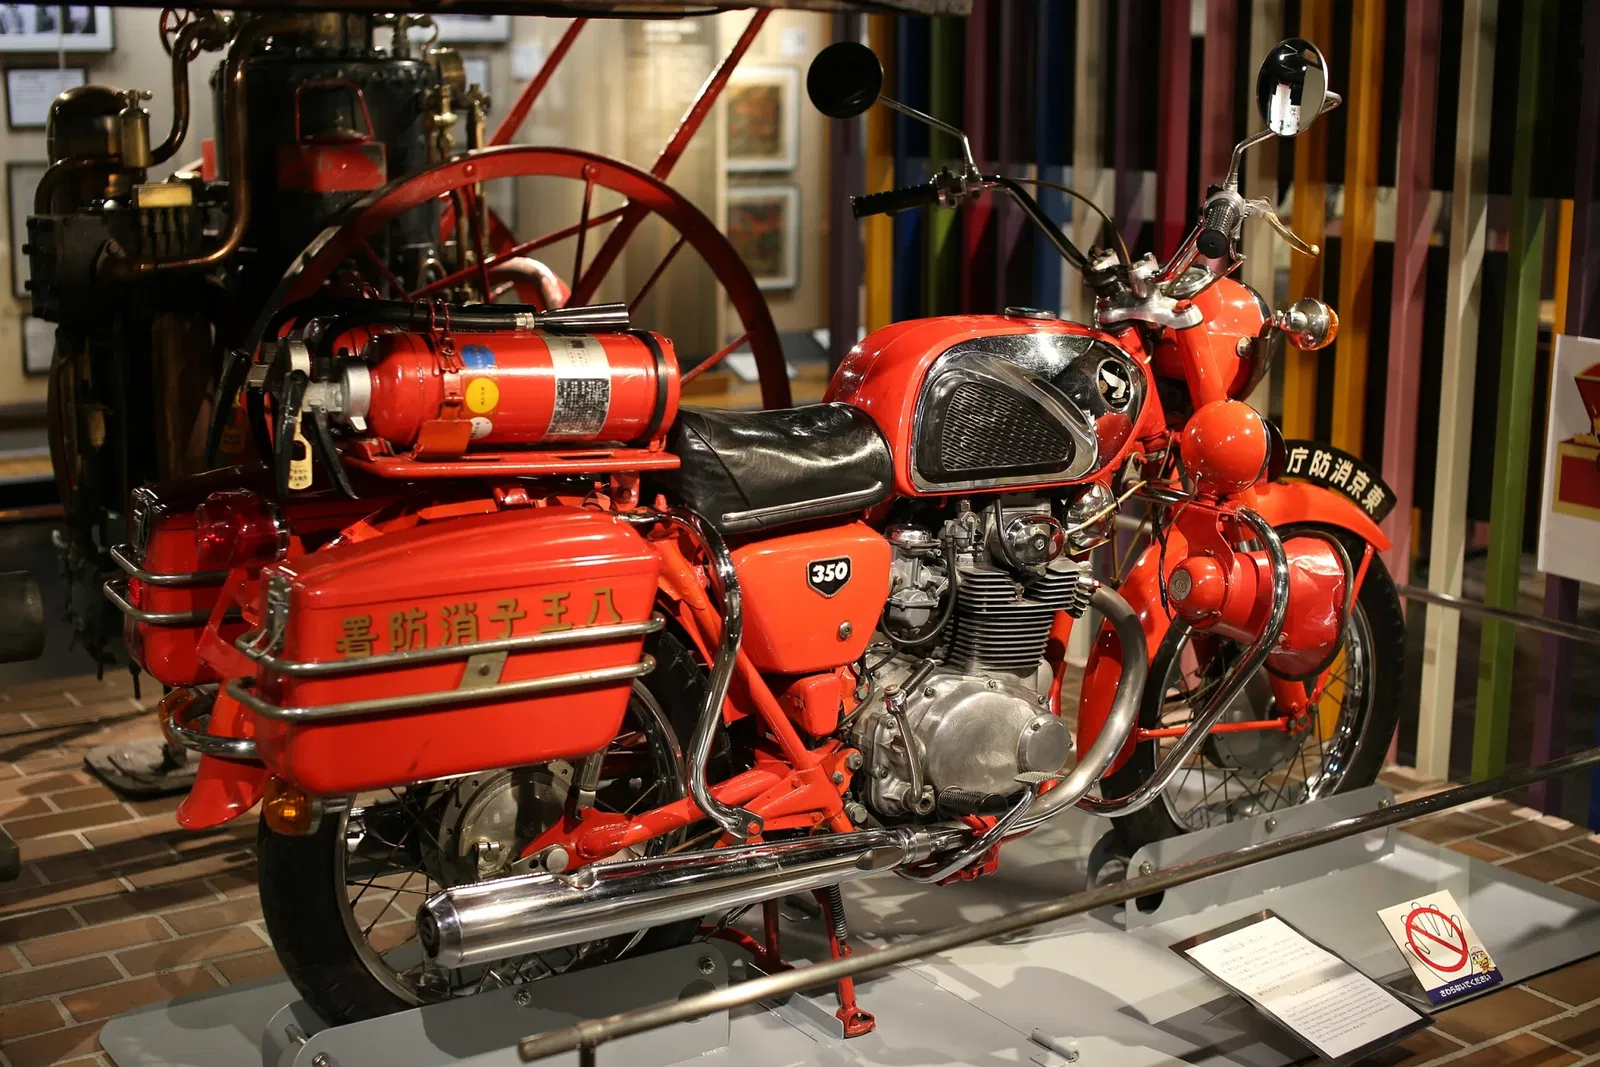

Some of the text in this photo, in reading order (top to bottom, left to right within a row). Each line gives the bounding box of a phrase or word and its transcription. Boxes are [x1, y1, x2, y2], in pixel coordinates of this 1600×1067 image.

[812, 561, 848, 583] 350
[1440, 974, 1491, 998] さわらないでください
